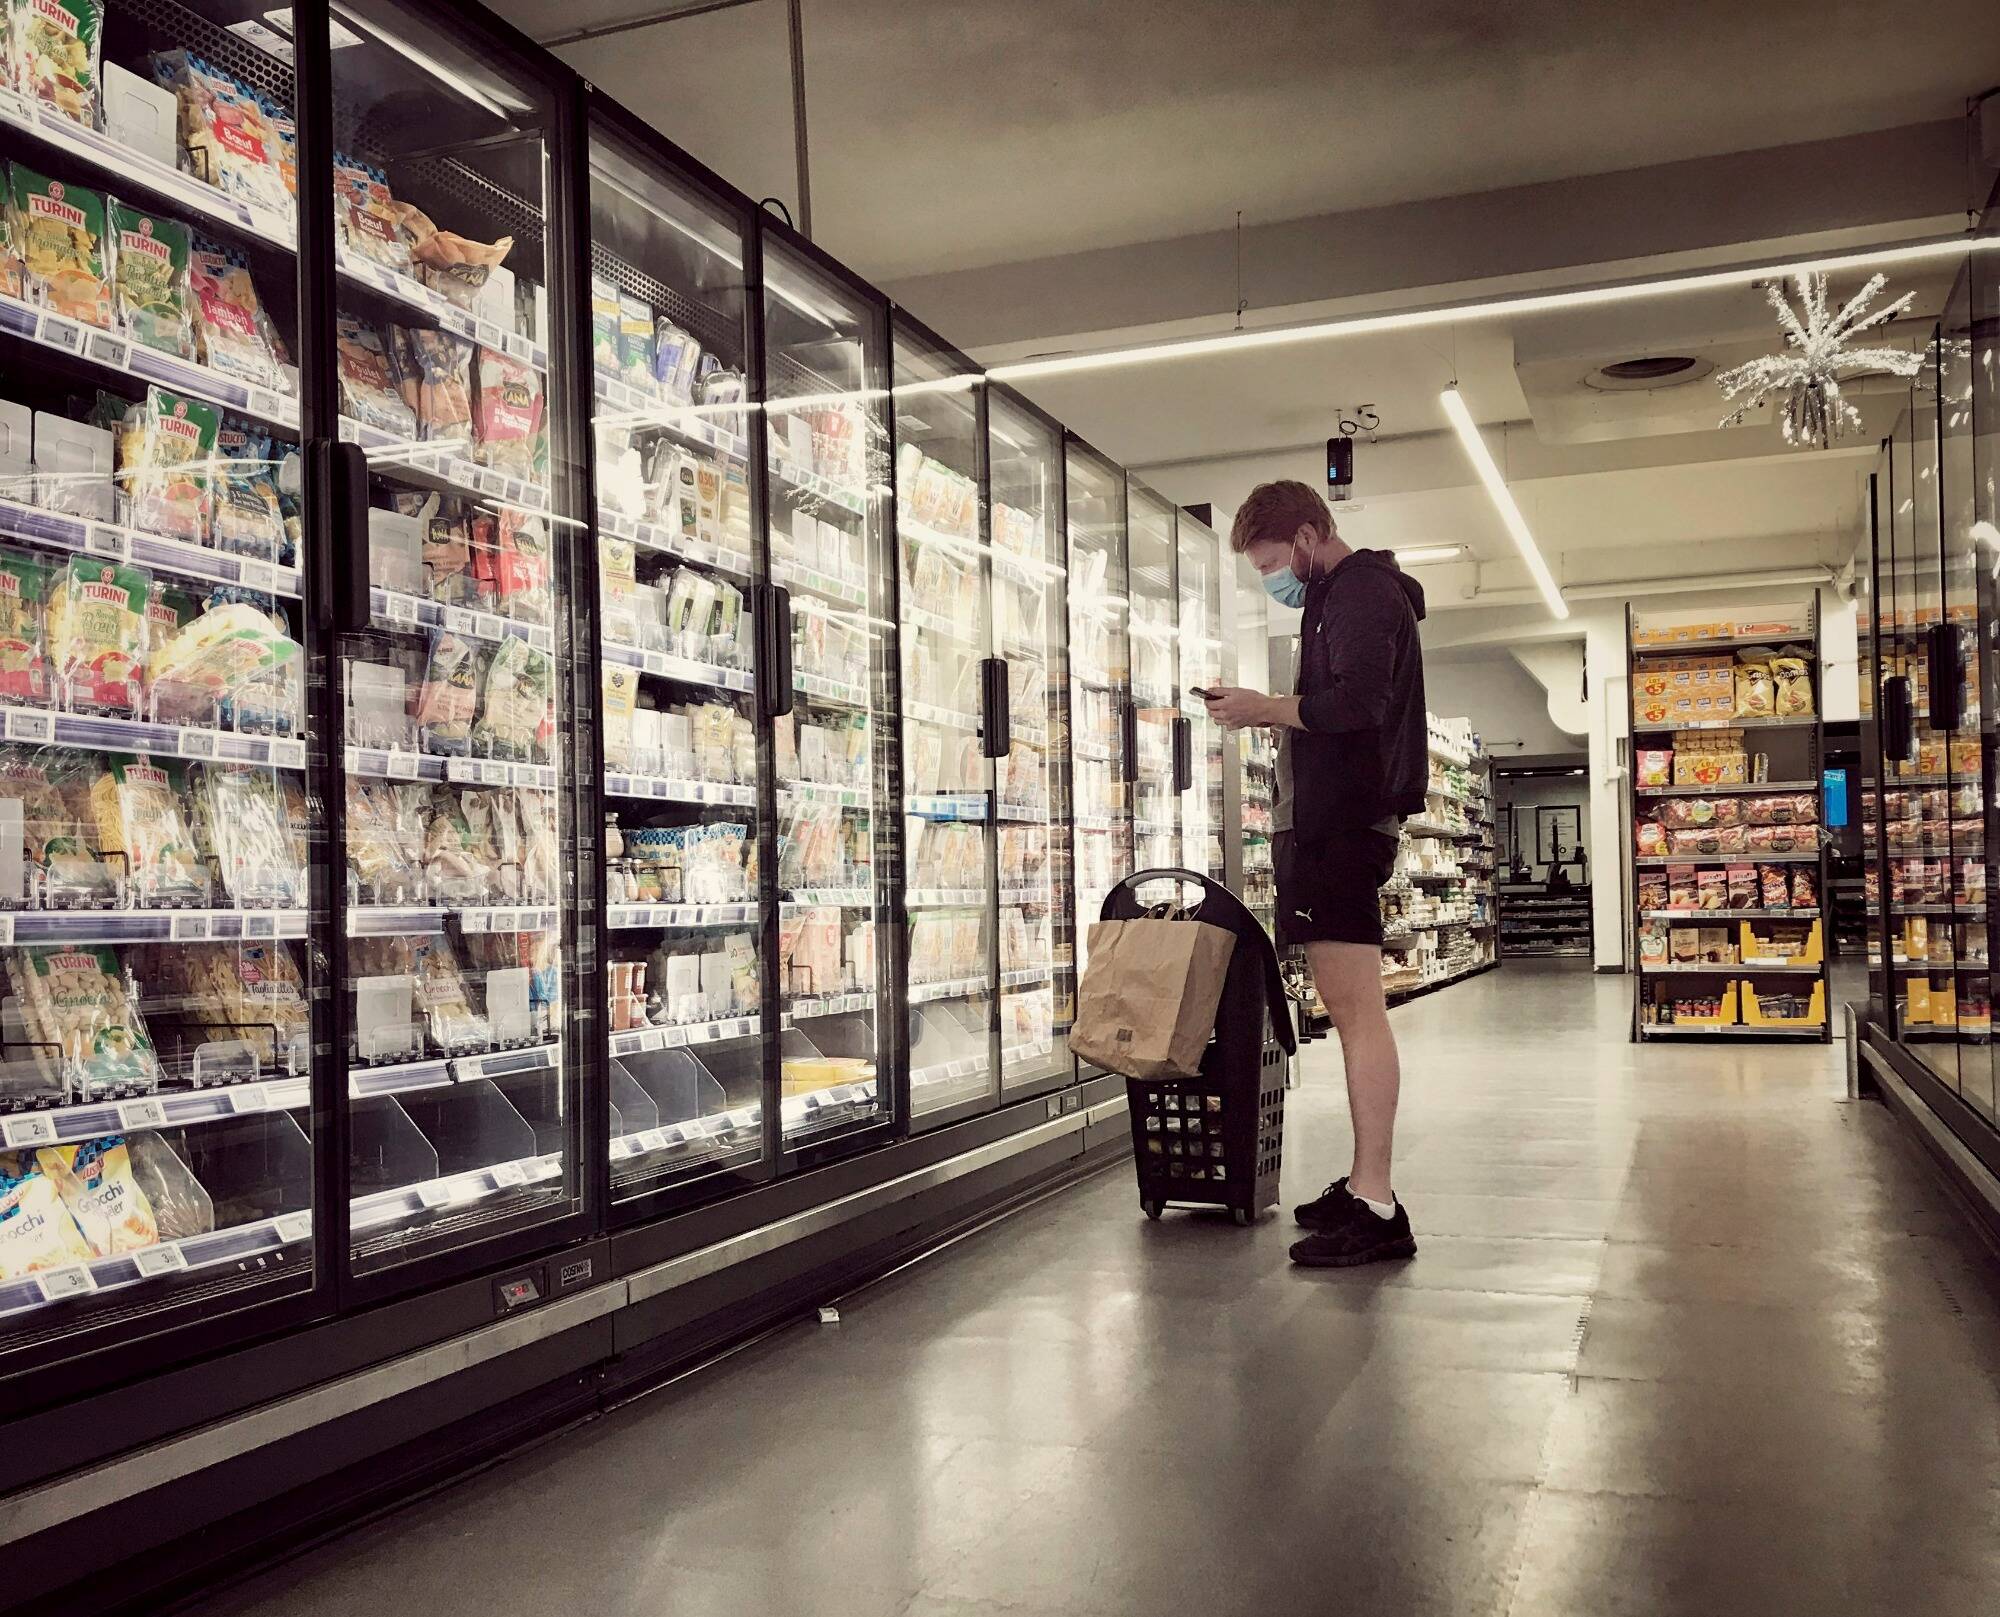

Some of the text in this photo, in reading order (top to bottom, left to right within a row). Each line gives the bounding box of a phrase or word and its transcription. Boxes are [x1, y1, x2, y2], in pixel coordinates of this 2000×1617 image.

[32, 0, 76, 30] TURINI
[31, 197, 83, 225] TURINI
[356, 211, 383, 231] Bœuf
[123, 234, 167, 260] TURINI
[349, 360, 381, 381] Poulet
[159, 418, 198, 440] TURINI
[84, 585, 127, 604] TURINI
[126, 767, 167, 785] TURINI
[50, 956, 96, 969] TURINI
[77, 1181, 125, 1215] Gnocchi
[0, 1214, 45, 1245] nocchi
